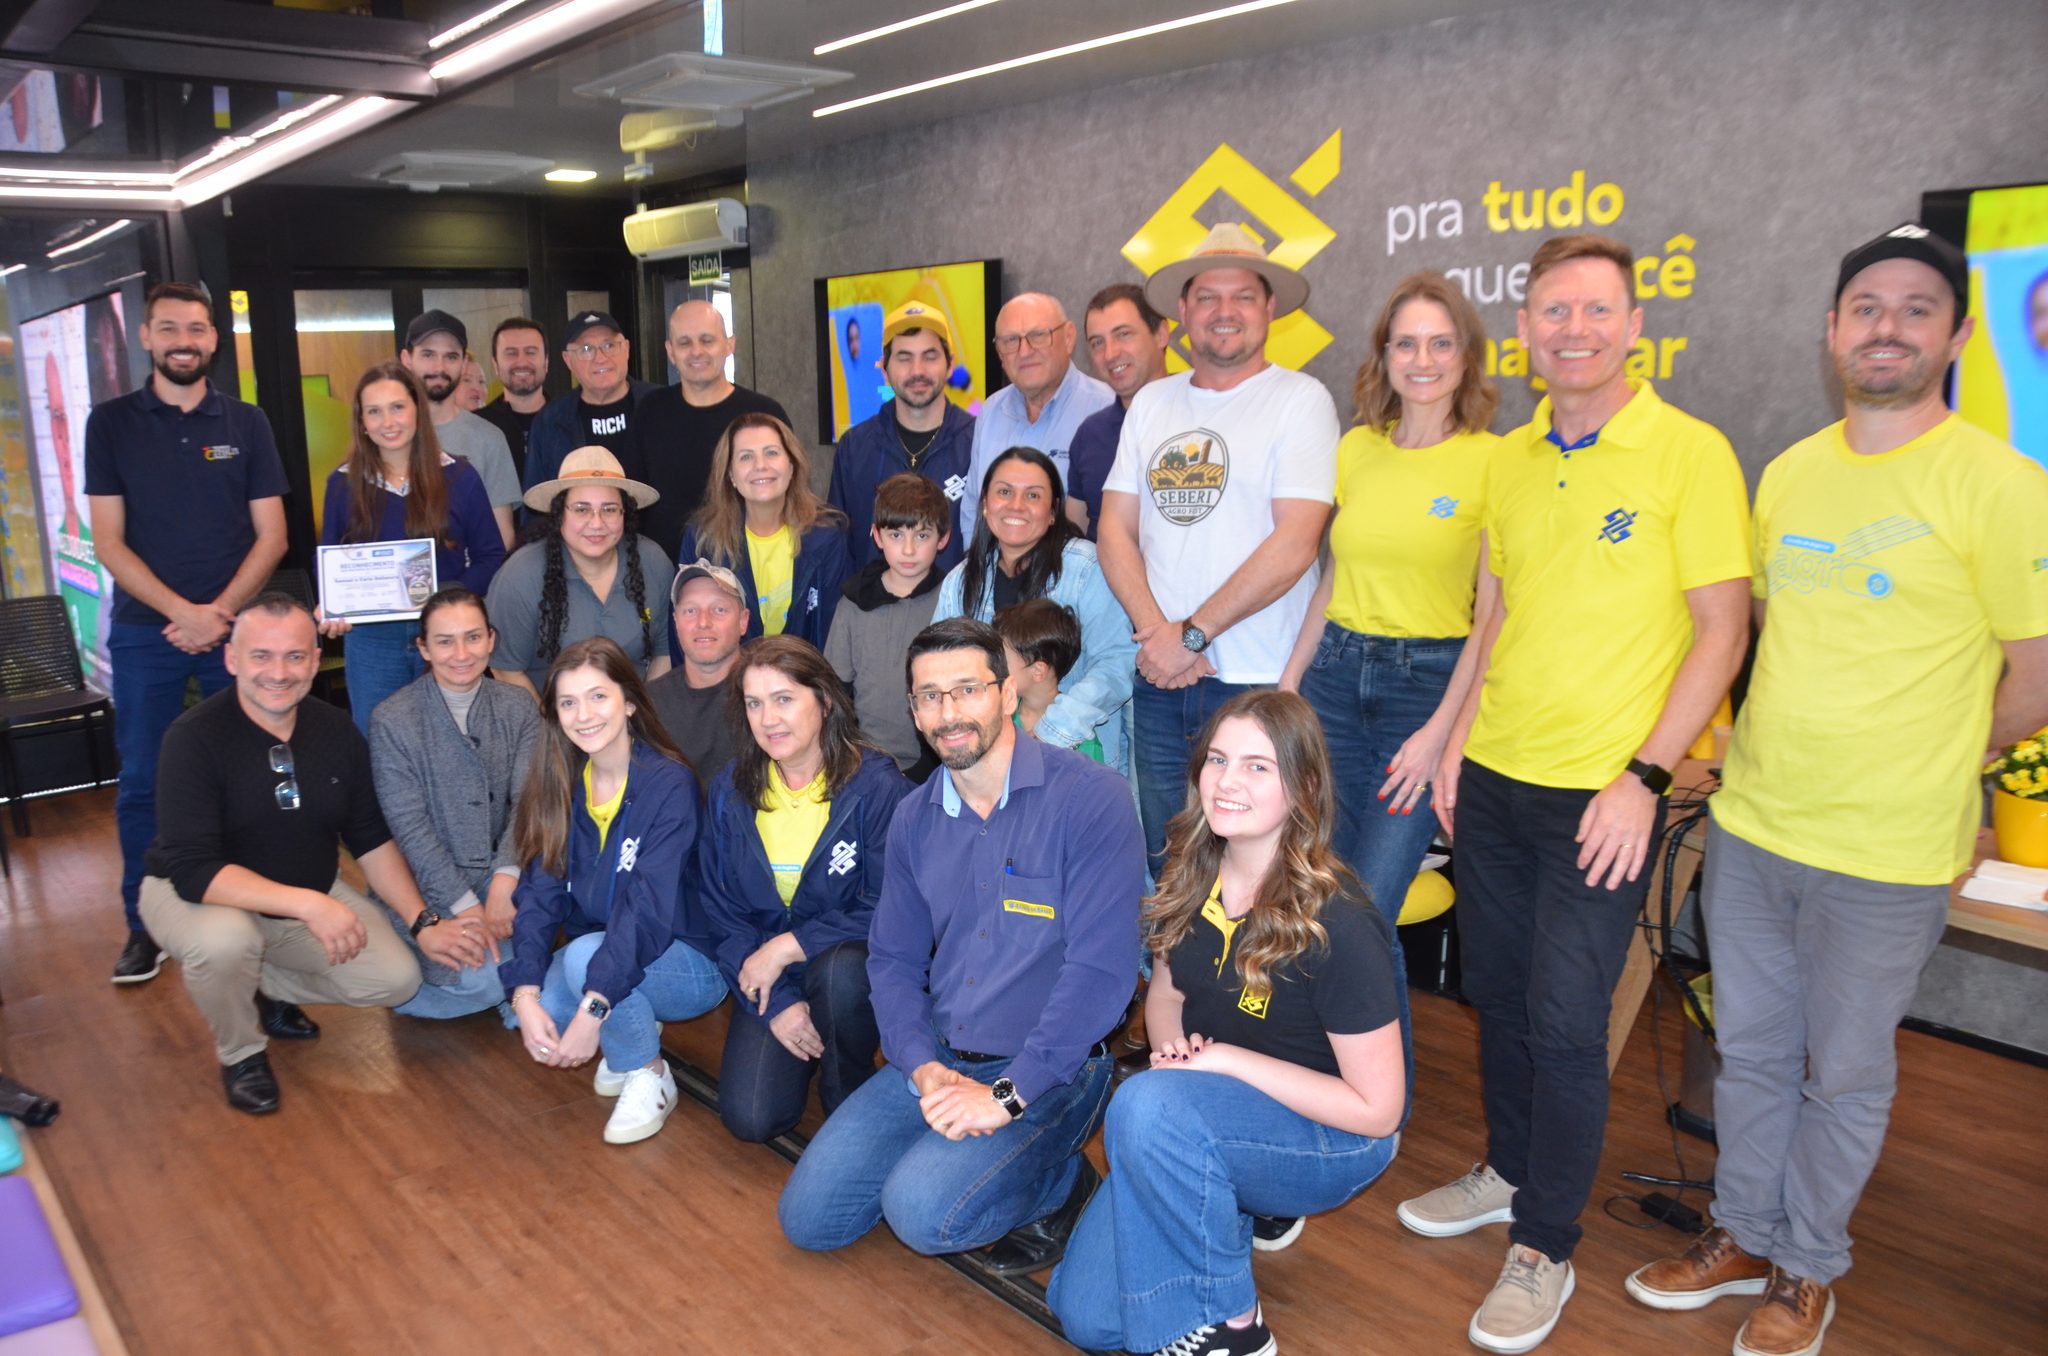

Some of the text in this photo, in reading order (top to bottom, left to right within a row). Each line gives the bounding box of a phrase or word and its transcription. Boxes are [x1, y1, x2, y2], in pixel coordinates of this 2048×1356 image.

[1386, 169, 1625, 256] pra tudo
[691, 255, 719, 276] SAÍDA
[591, 413, 626, 435] RICH
[1160, 490, 1212, 505] SEBERI
